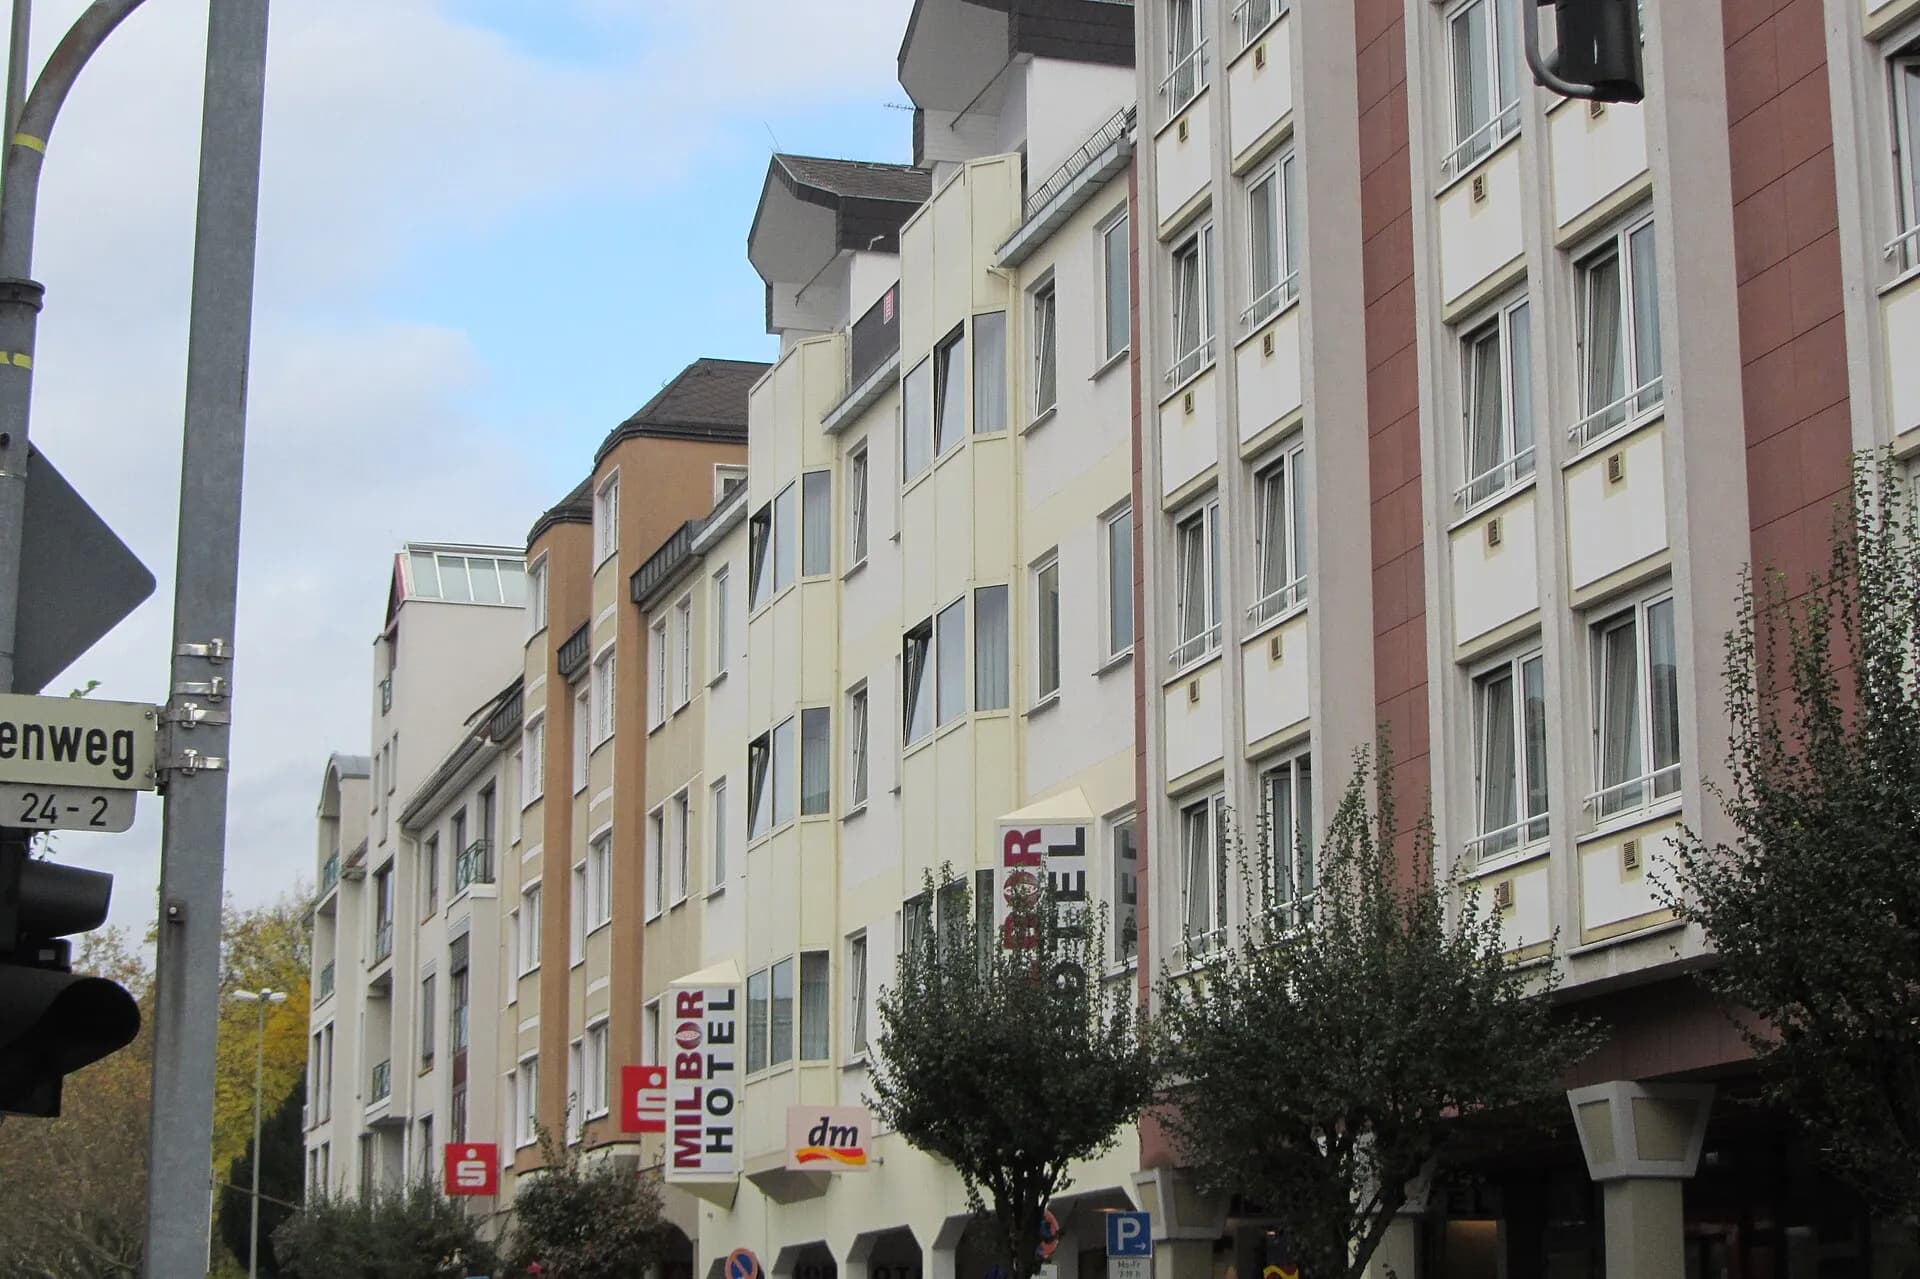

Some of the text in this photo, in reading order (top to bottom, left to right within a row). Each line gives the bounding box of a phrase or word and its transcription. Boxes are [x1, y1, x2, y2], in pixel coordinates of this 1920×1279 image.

[0, 721, 135, 781] enweg
[674, 990, 704, 1169] MILBOR
[706, 989, 735, 1154] HOTEL
[808, 1116, 859, 1148] dm
[1118, 1218, 1141, 1251] P
